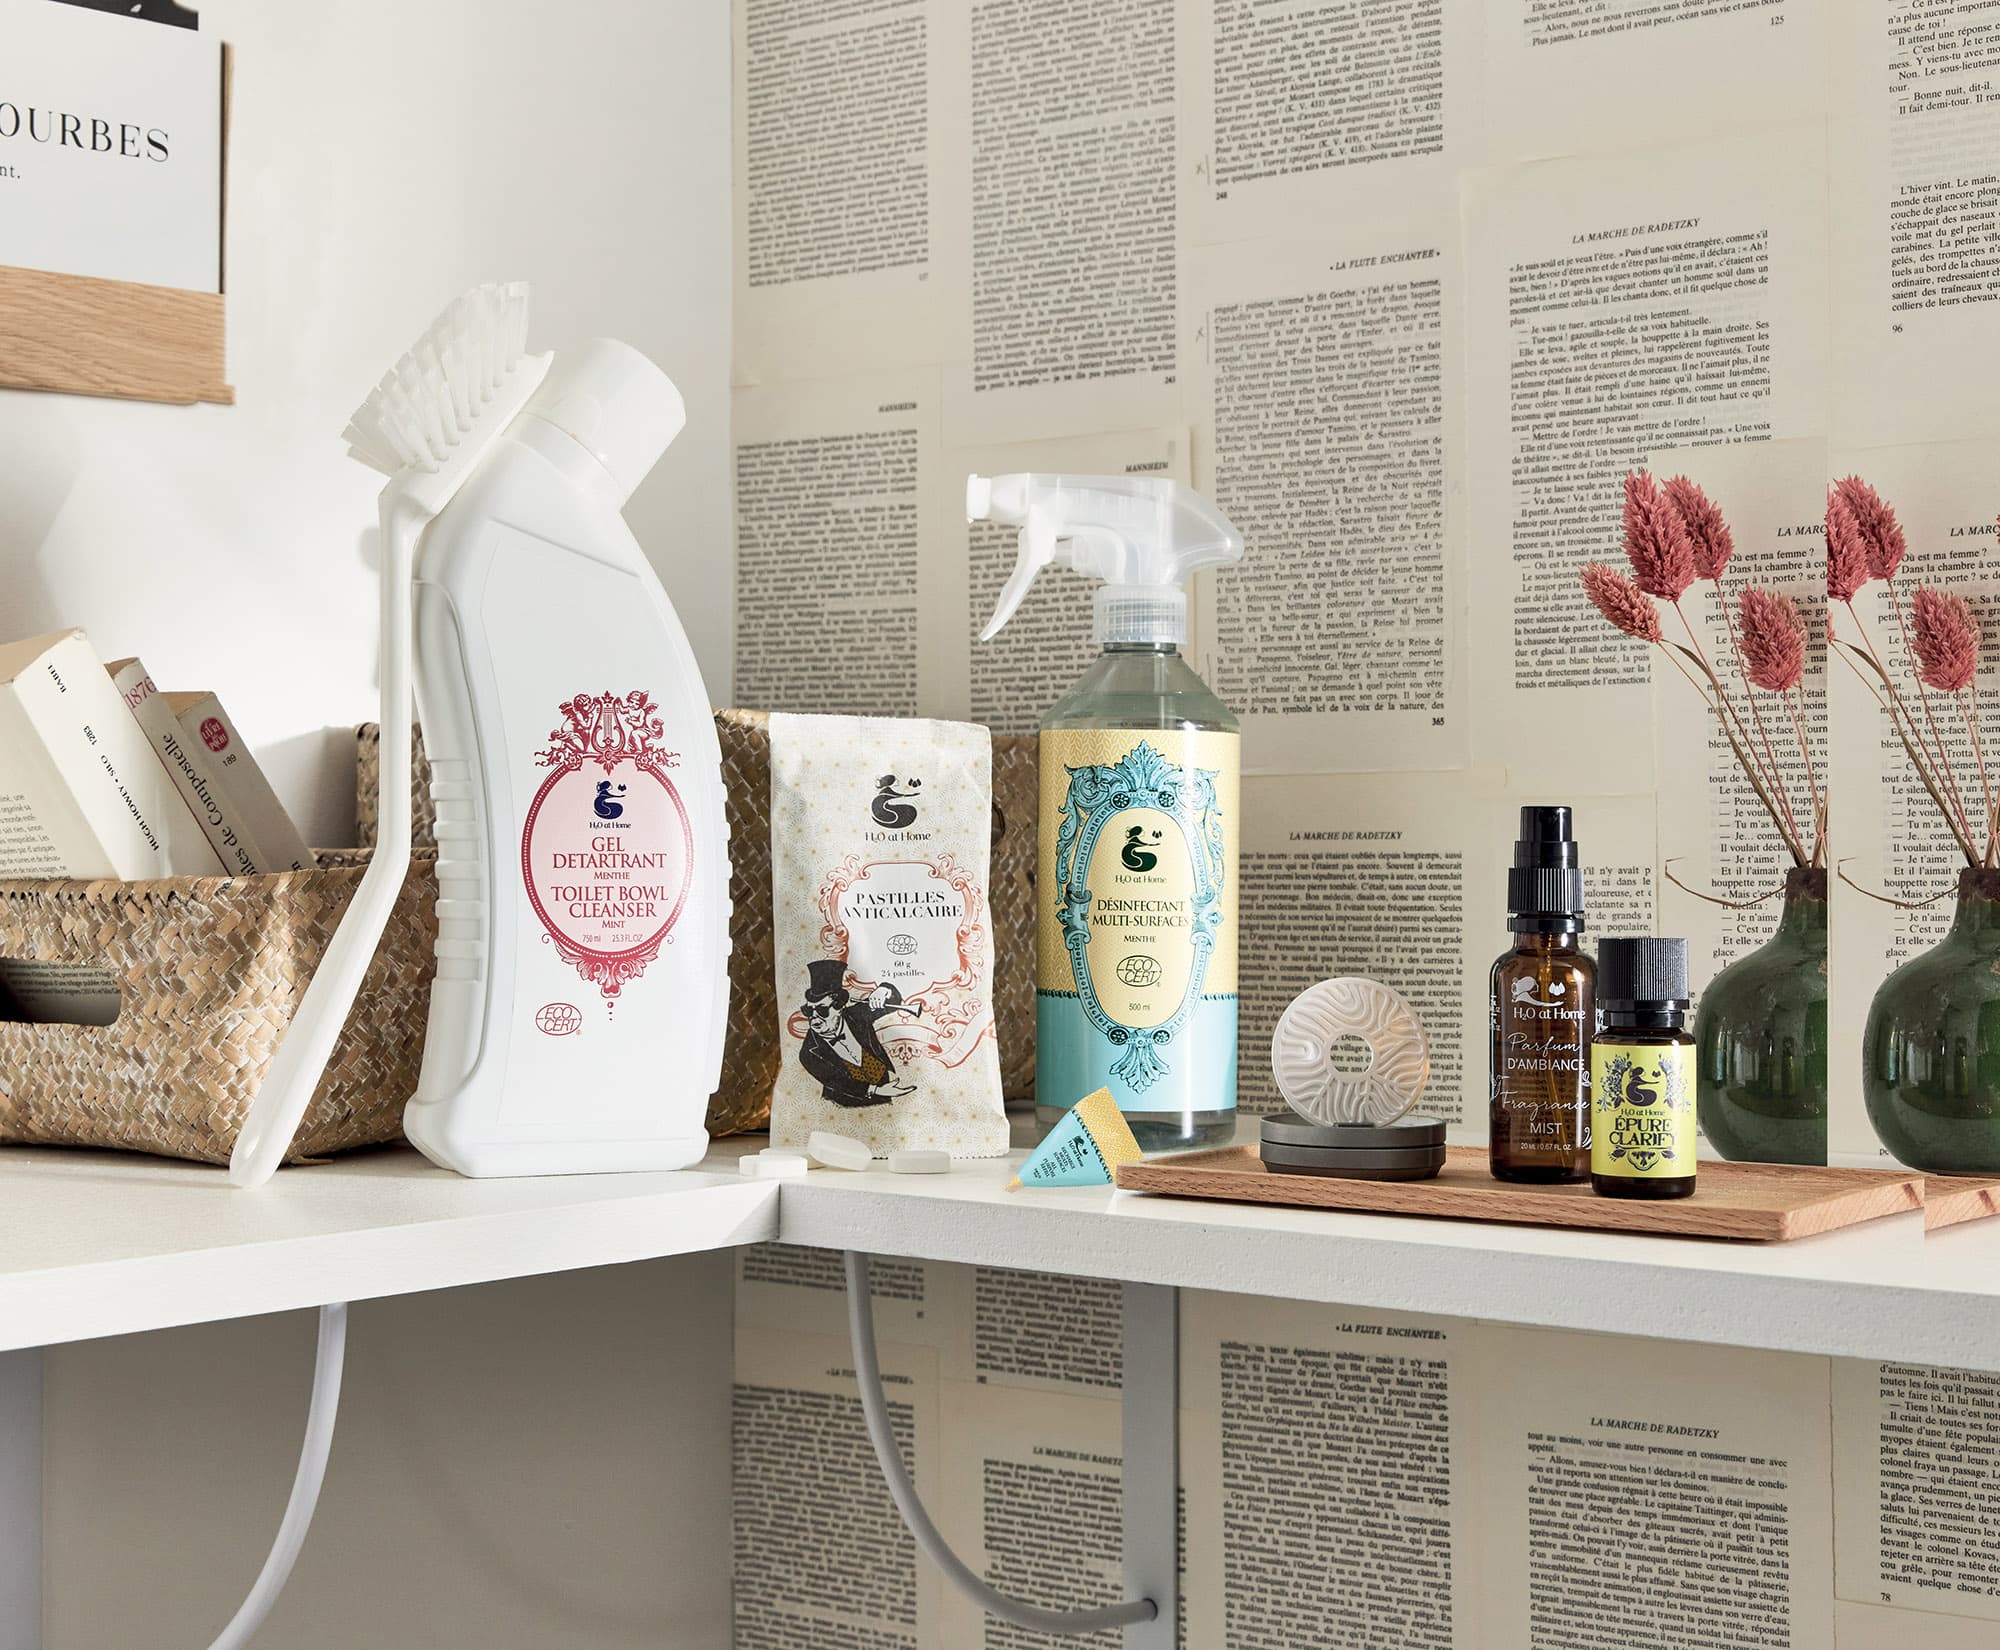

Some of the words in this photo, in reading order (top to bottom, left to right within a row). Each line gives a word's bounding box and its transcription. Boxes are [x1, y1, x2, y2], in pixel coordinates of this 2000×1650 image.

[1634, 18, 1652, 29] avait
[1654, 16, 1674, 27] peur,
[1701, 8, 1717, 17] sans
[1719, 4, 1731, 14] vie
[1770, 16, 1785, 26] 125
[1904, 12, 1921, 23] plus
[1924, 8, 1954, 19] aucune
[1908, 32, 1936, 44] attend
[1938, 31, 1955, 39] une
[1958, 24, 1992, 37] réponse
[1889, 84, 1910, 93] tour.
[1914, 90, 1942, 101] Bonne
[1945, 87, 1966, 96] nuit,
[1969, 81, 1993, 92] dit-il.
[0, 102, 169, 163] OURBES
[1900, 184, 1932, 196] L'hiver
[1934, 181, 1954, 191] vint.
[1572, 234, 1585, 244] LA
[1587, 228, 1629, 242] MARCHE
[1631, 225, 1646, 236] DE
[1647, 217, 1701, 234] RADETZKY
[1954, 235, 1980, 249] petite
[1938, 246, 1986, 260] trompettes
[1349, 256, 1377, 269] FLUTE
[1700, 280, 1733, 292] quelque
[1734, 276, 1757, 287] chose
[1892, 323, 1903, 333] 96
[1704, 335, 1756, 348] fugitivement
[1777, 527, 1792, 537] LA
[1950, 527, 1965, 537] LA
[1744, 552, 1758, 561] est
[1760, 552, 1774, 561] ma
[1777, 549, 1808, 559] femme
[1950, 549, 1981, 559] femme
[1729, 564, 1752, 574] Dans
[1765, 561, 1803, 572] chambre
[1938, 561, 1976, 572] chambre
[83, 725, 98, 746] 1283
[100, 755, 117, 777] SILO
[222, 753, 237, 767] 189
[163, 732, 223, 826] Compostelle
[118, 785, 142, 821] HOWEY
[612, 821, 631, 829] Home
[140, 820, 160, 852] HUGH
[222, 826, 238, 847] de
[888, 832, 899, 842] at
[901, 831, 932, 842] Home
[1289, 832, 1300, 841] LA
[1303, 832, 1340, 840] MARCHE
[1341, 832, 1354, 840] DE
[1356, 831, 1403, 841] RADETZKY
[592, 836, 625, 852] GEL
[553, 853, 667, 868] DETARTRANT
[1735, 855, 1745, 864] Je
[1747, 855, 1775, 863] t'aime
[1908, 855, 1918, 864] Je
[1920, 855, 1947, 863] t'aime
[594, 871, 630, 880] MENTHE
[1618, 866, 1639, 874] avait
[1746, 866, 1779, 875] l'aimait
[1143, 875, 1167, 883] Home
[1616, 878, 1637, 886] dans
[1711, 878, 1756, 891] houppette
[1758, 879, 1777, 887] rose
[551, 886, 614, 901] TOILET
[619, 886, 668, 901] BOWL
[857, 891, 945, 905] PASTILLES
[568, 902, 657, 918] CLEANSER
[1097, 897, 1184, 912] DÉSINFECTANT
[1585, 900, 1625, 909] éclatante
[845, 905, 963, 920] ANTICALCAIRE
[1611, 912, 1642, 921] grands
[601, 920, 625, 929] MINT
[1092, 915, 1189, 927] MULTI-SURFACES
[1607, 922, 1651, 933] populaire,
[1123, 935, 1157, 943] MENTHE
[1712, 948, 1738, 959] glace.
[894, 960, 904, 968] 60
[906, 961, 911, 969] g
[1125, 959, 1153, 971] ECO
[893, 969, 925, 979] pastilles
[1124, 970, 1159, 983] CERT
[545, 1006, 573, 1019] ECO
[1128, 1003, 1141, 1011] 500
[1538, 1007, 1551, 1020] at
[1554, 1007, 1586, 1020] Home
[544, 1018, 577, 1031] CERT
[1507, 1032, 1582, 1057] Parfum
[1507, 1058, 1585, 1071] D'AMBIANCE
[1500, 1091, 1590, 1121] Fragrance
[1530, 1122, 1563, 1135] MIST
[1615, 1115, 1672, 1132] ÉPURE
[1609, 1131, 1675, 1146] CLARIFY
[1341, 1323, 1353, 1333] LA
[1355, 1324, 1383, 1336] FLUTE
[1904, 1401, 1928, 1413] Tiens
[1590, 1417, 1604, 1427] LA
[1606, 1419, 1648, 1432] MARCHE
[1650, 1423, 1664, 1434] DE
[1666, 1425, 1720, 1439] RADETZKY
[1952, 1466, 1989, 1479] passage.
[1880, 1513, 1922, 1528] difficulté,
[1964, 1549, 1999, 1562] Kovacs,
[1916, 1578, 1952, 1590] quelque
[1956, 1583, 1982, 1594] chose
[1880, 1592, 1891, 1601] 78
